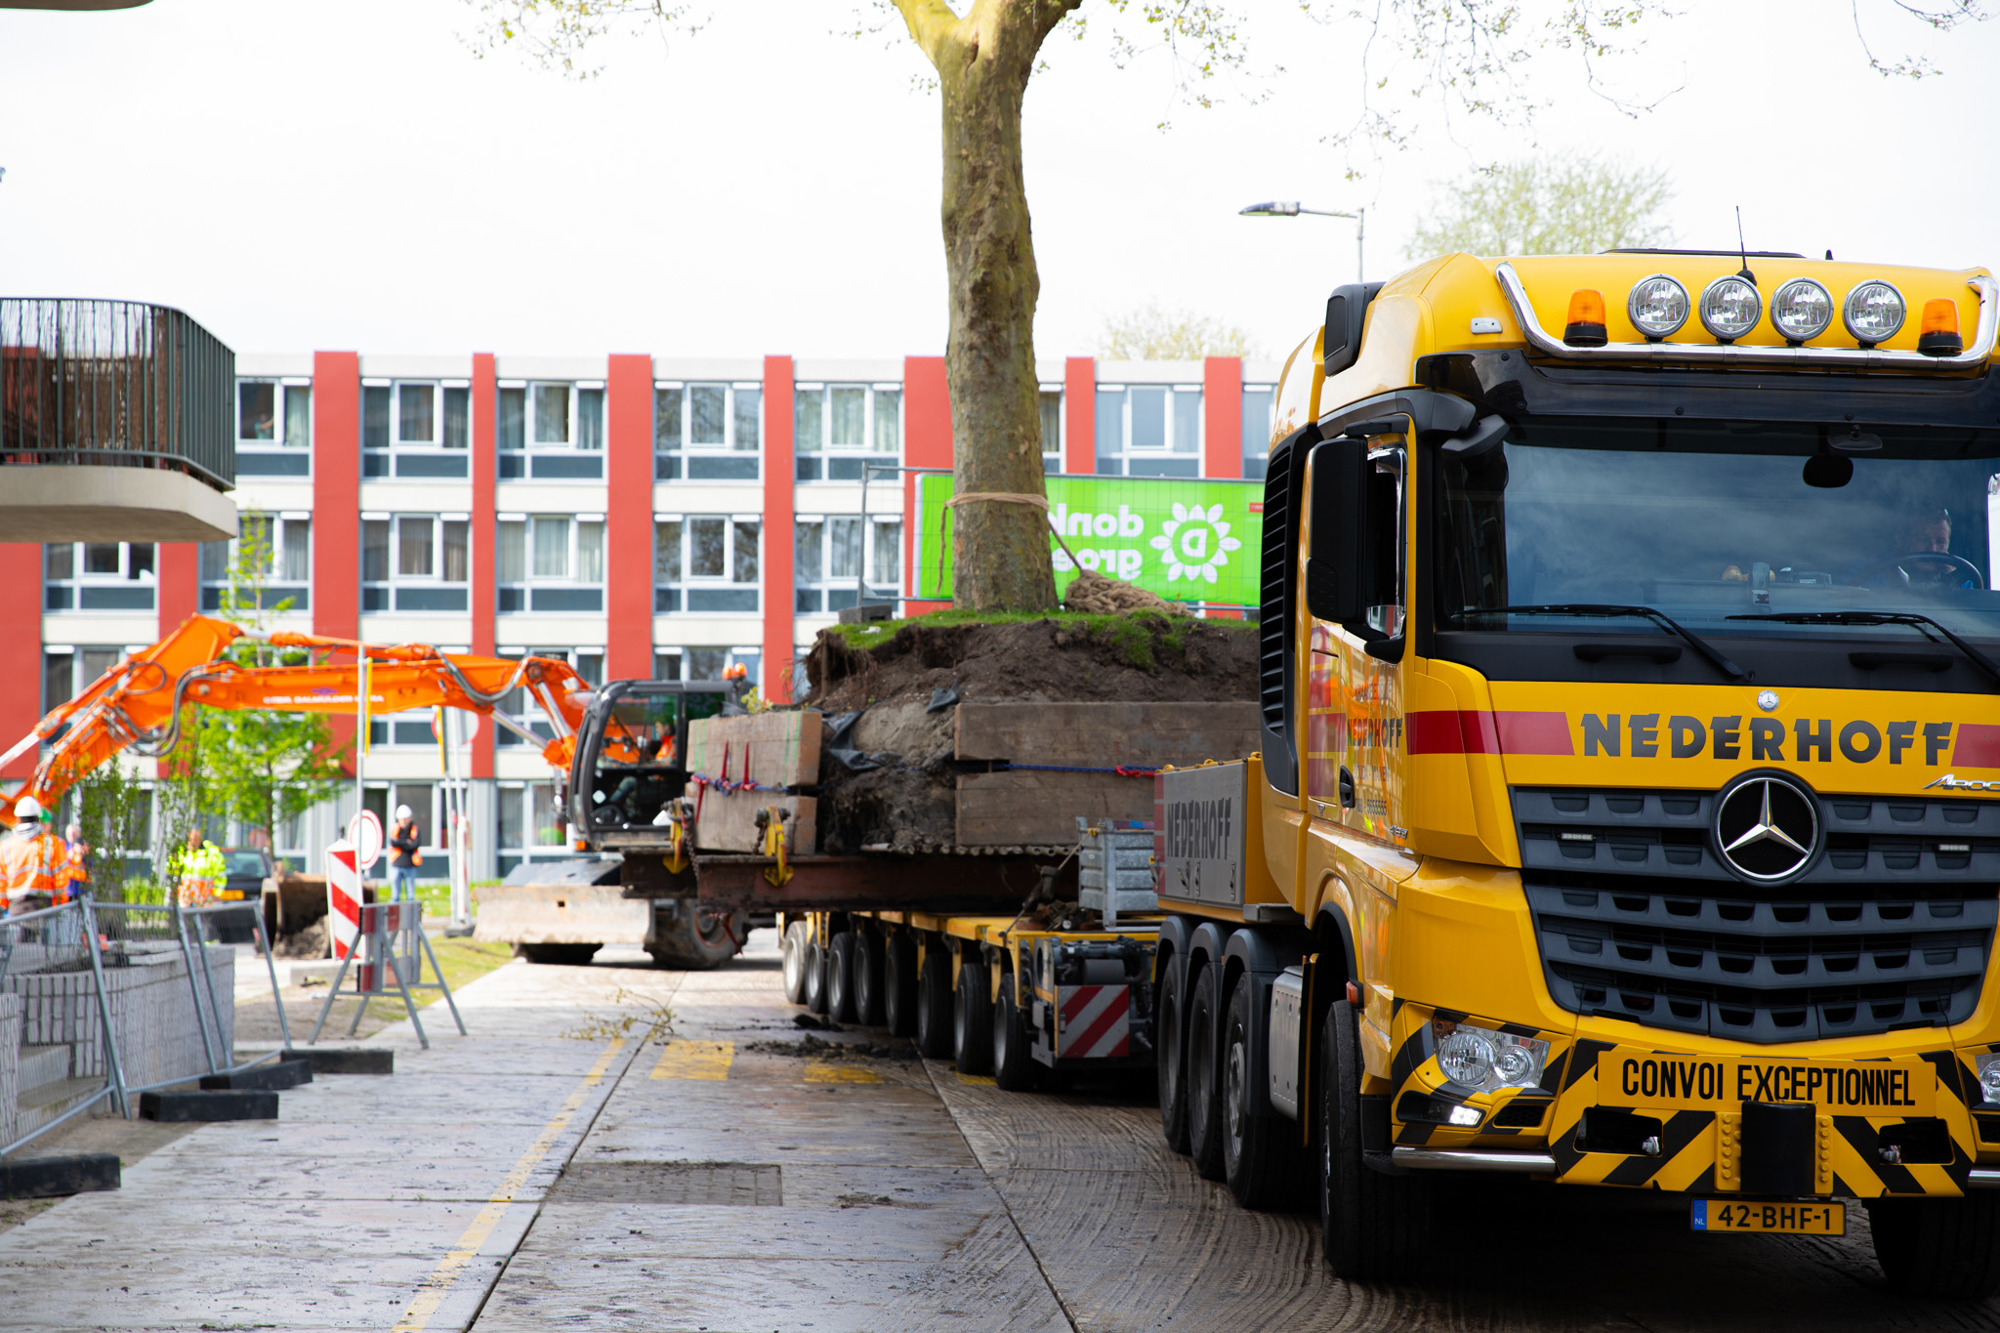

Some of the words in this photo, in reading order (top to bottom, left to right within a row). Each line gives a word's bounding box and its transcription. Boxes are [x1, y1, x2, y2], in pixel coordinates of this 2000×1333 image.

[1347, 717, 1402, 748] NEDERHOFF
[1580, 713, 1953, 766] NEDERHOFF
[1922, 774, 2000, 791] AROC
[1167, 797, 1231, 860] NEDERHOFF
[1622, 1059, 1724, 1100] CONVOI
[1737, 1064, 1916, 1106] EXCEPTIONNEL
[1694, 1217, 1705, 1226] NL
[1718, 1204, 1830, 1230] 42-BHF-1
